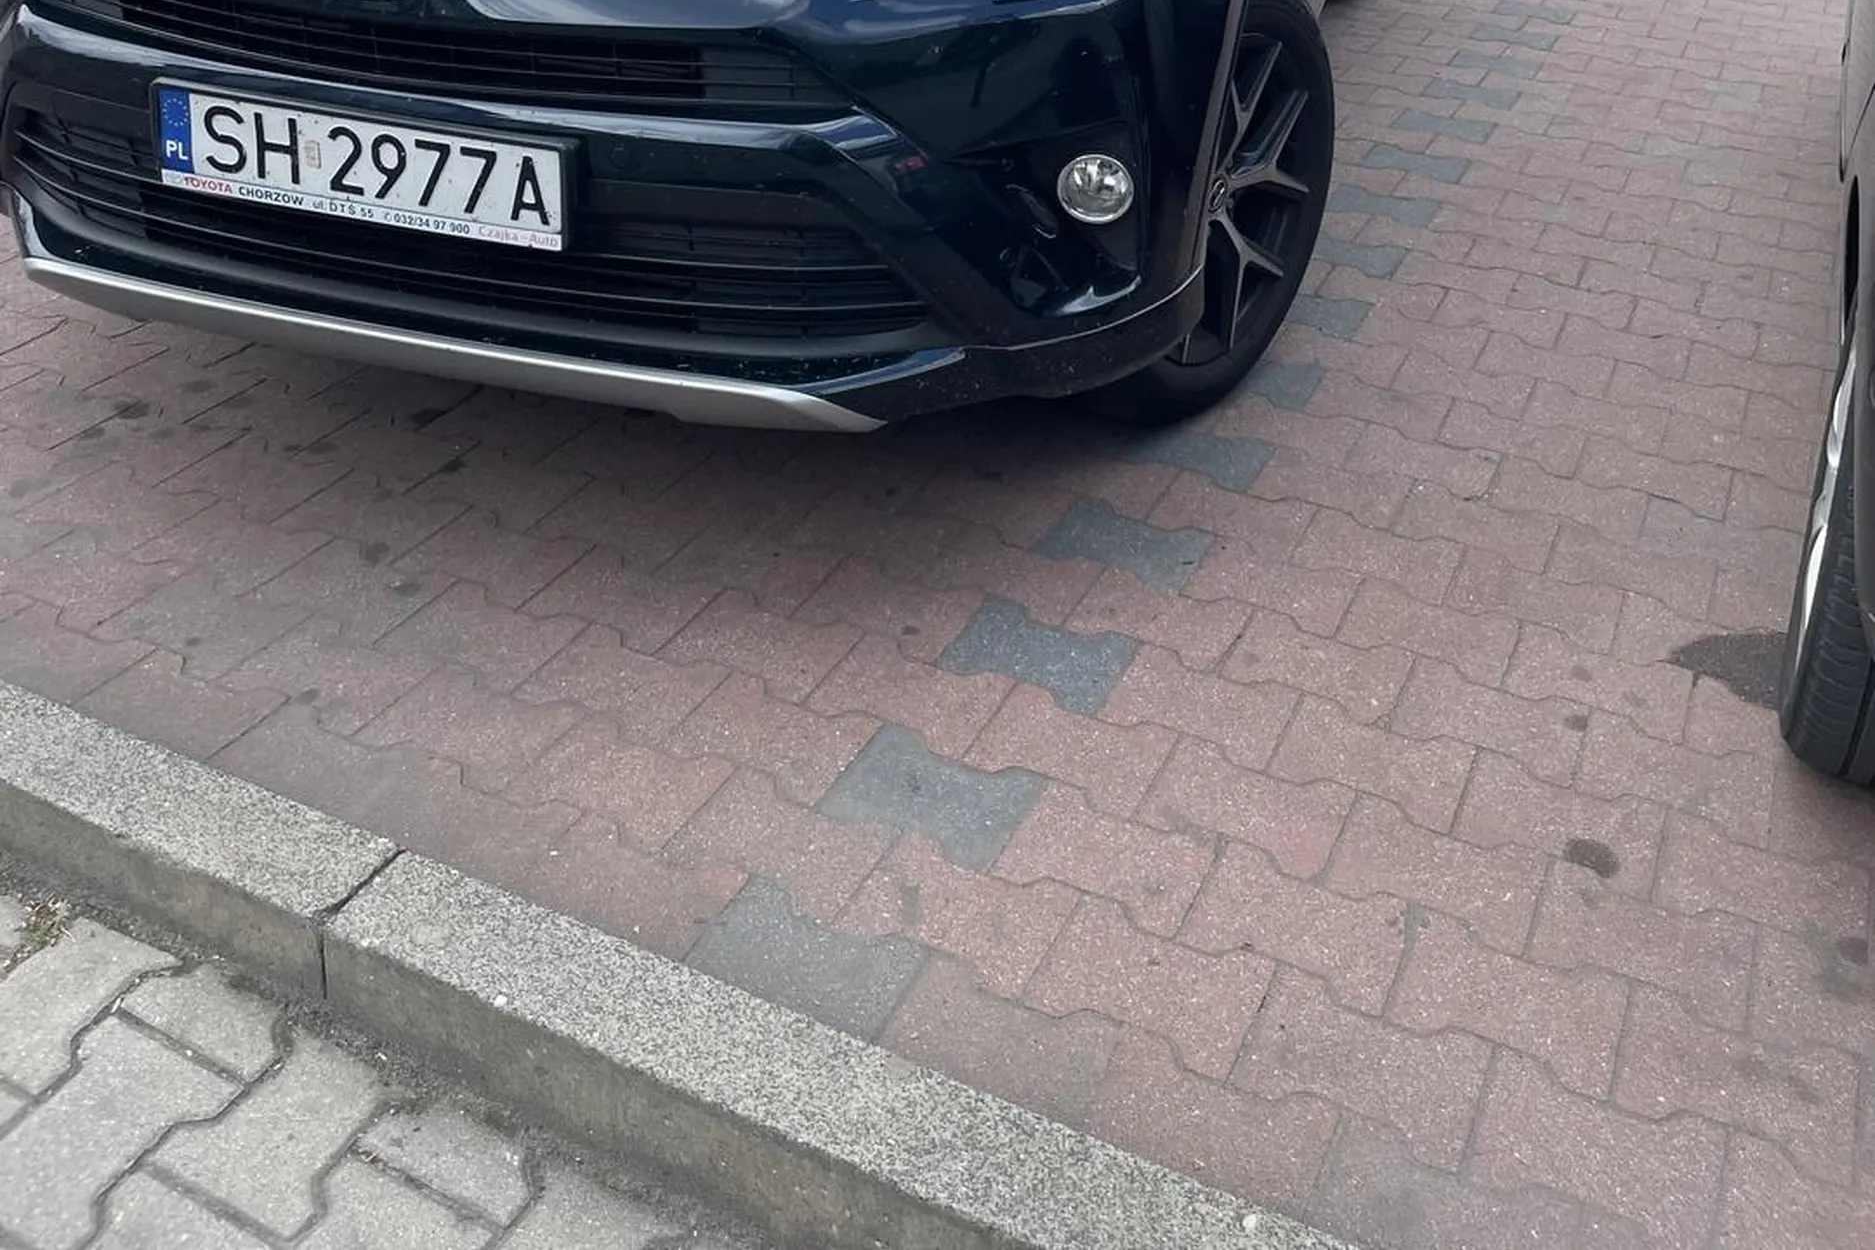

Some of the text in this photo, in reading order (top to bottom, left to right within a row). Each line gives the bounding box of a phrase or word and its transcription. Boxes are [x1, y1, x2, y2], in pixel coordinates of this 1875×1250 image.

[166, 139, 189, 160] PL
[204, 105, 551, 226] SH 2977A
[183, 176, 233, 195] TOYOTA
